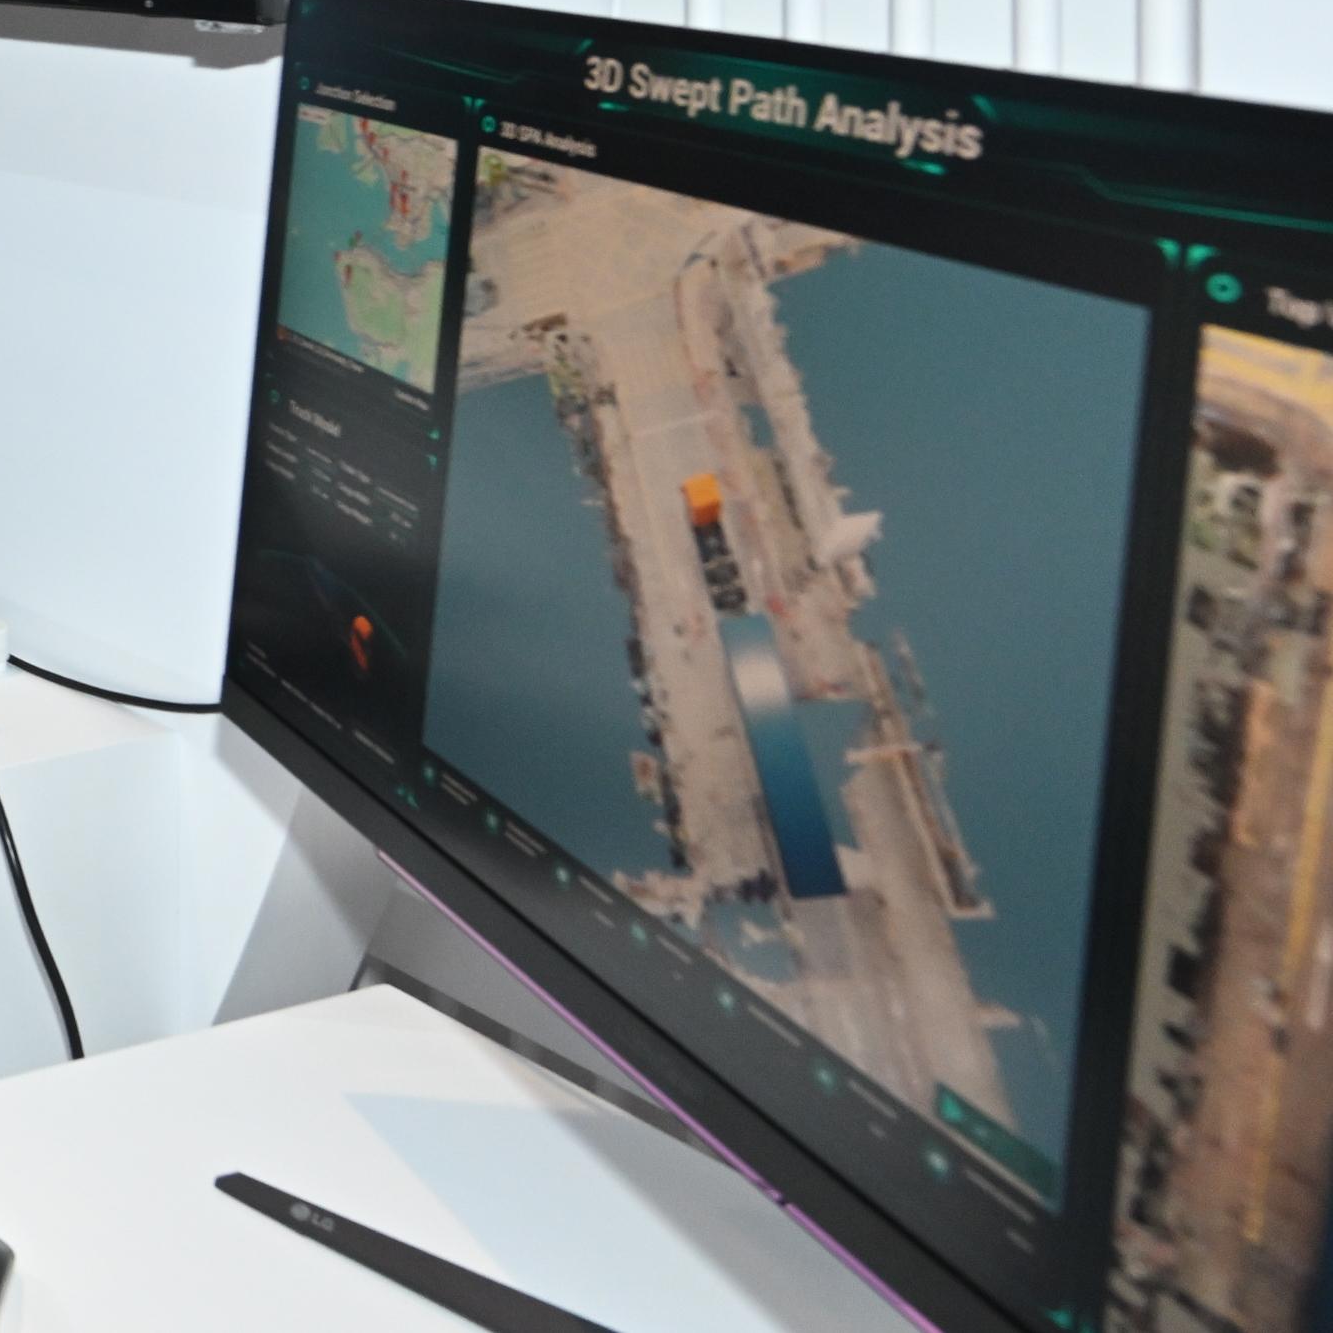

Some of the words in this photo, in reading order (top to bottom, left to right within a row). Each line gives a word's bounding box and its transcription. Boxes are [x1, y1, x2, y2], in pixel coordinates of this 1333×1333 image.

[584, 55, 625, 94] 3D
[628, 62, 723, 119] Swept
[727, 78, 808, 128] Path
[813, 92, 984, 161] Analysis
[309, 1211, 336, 1233] LG
